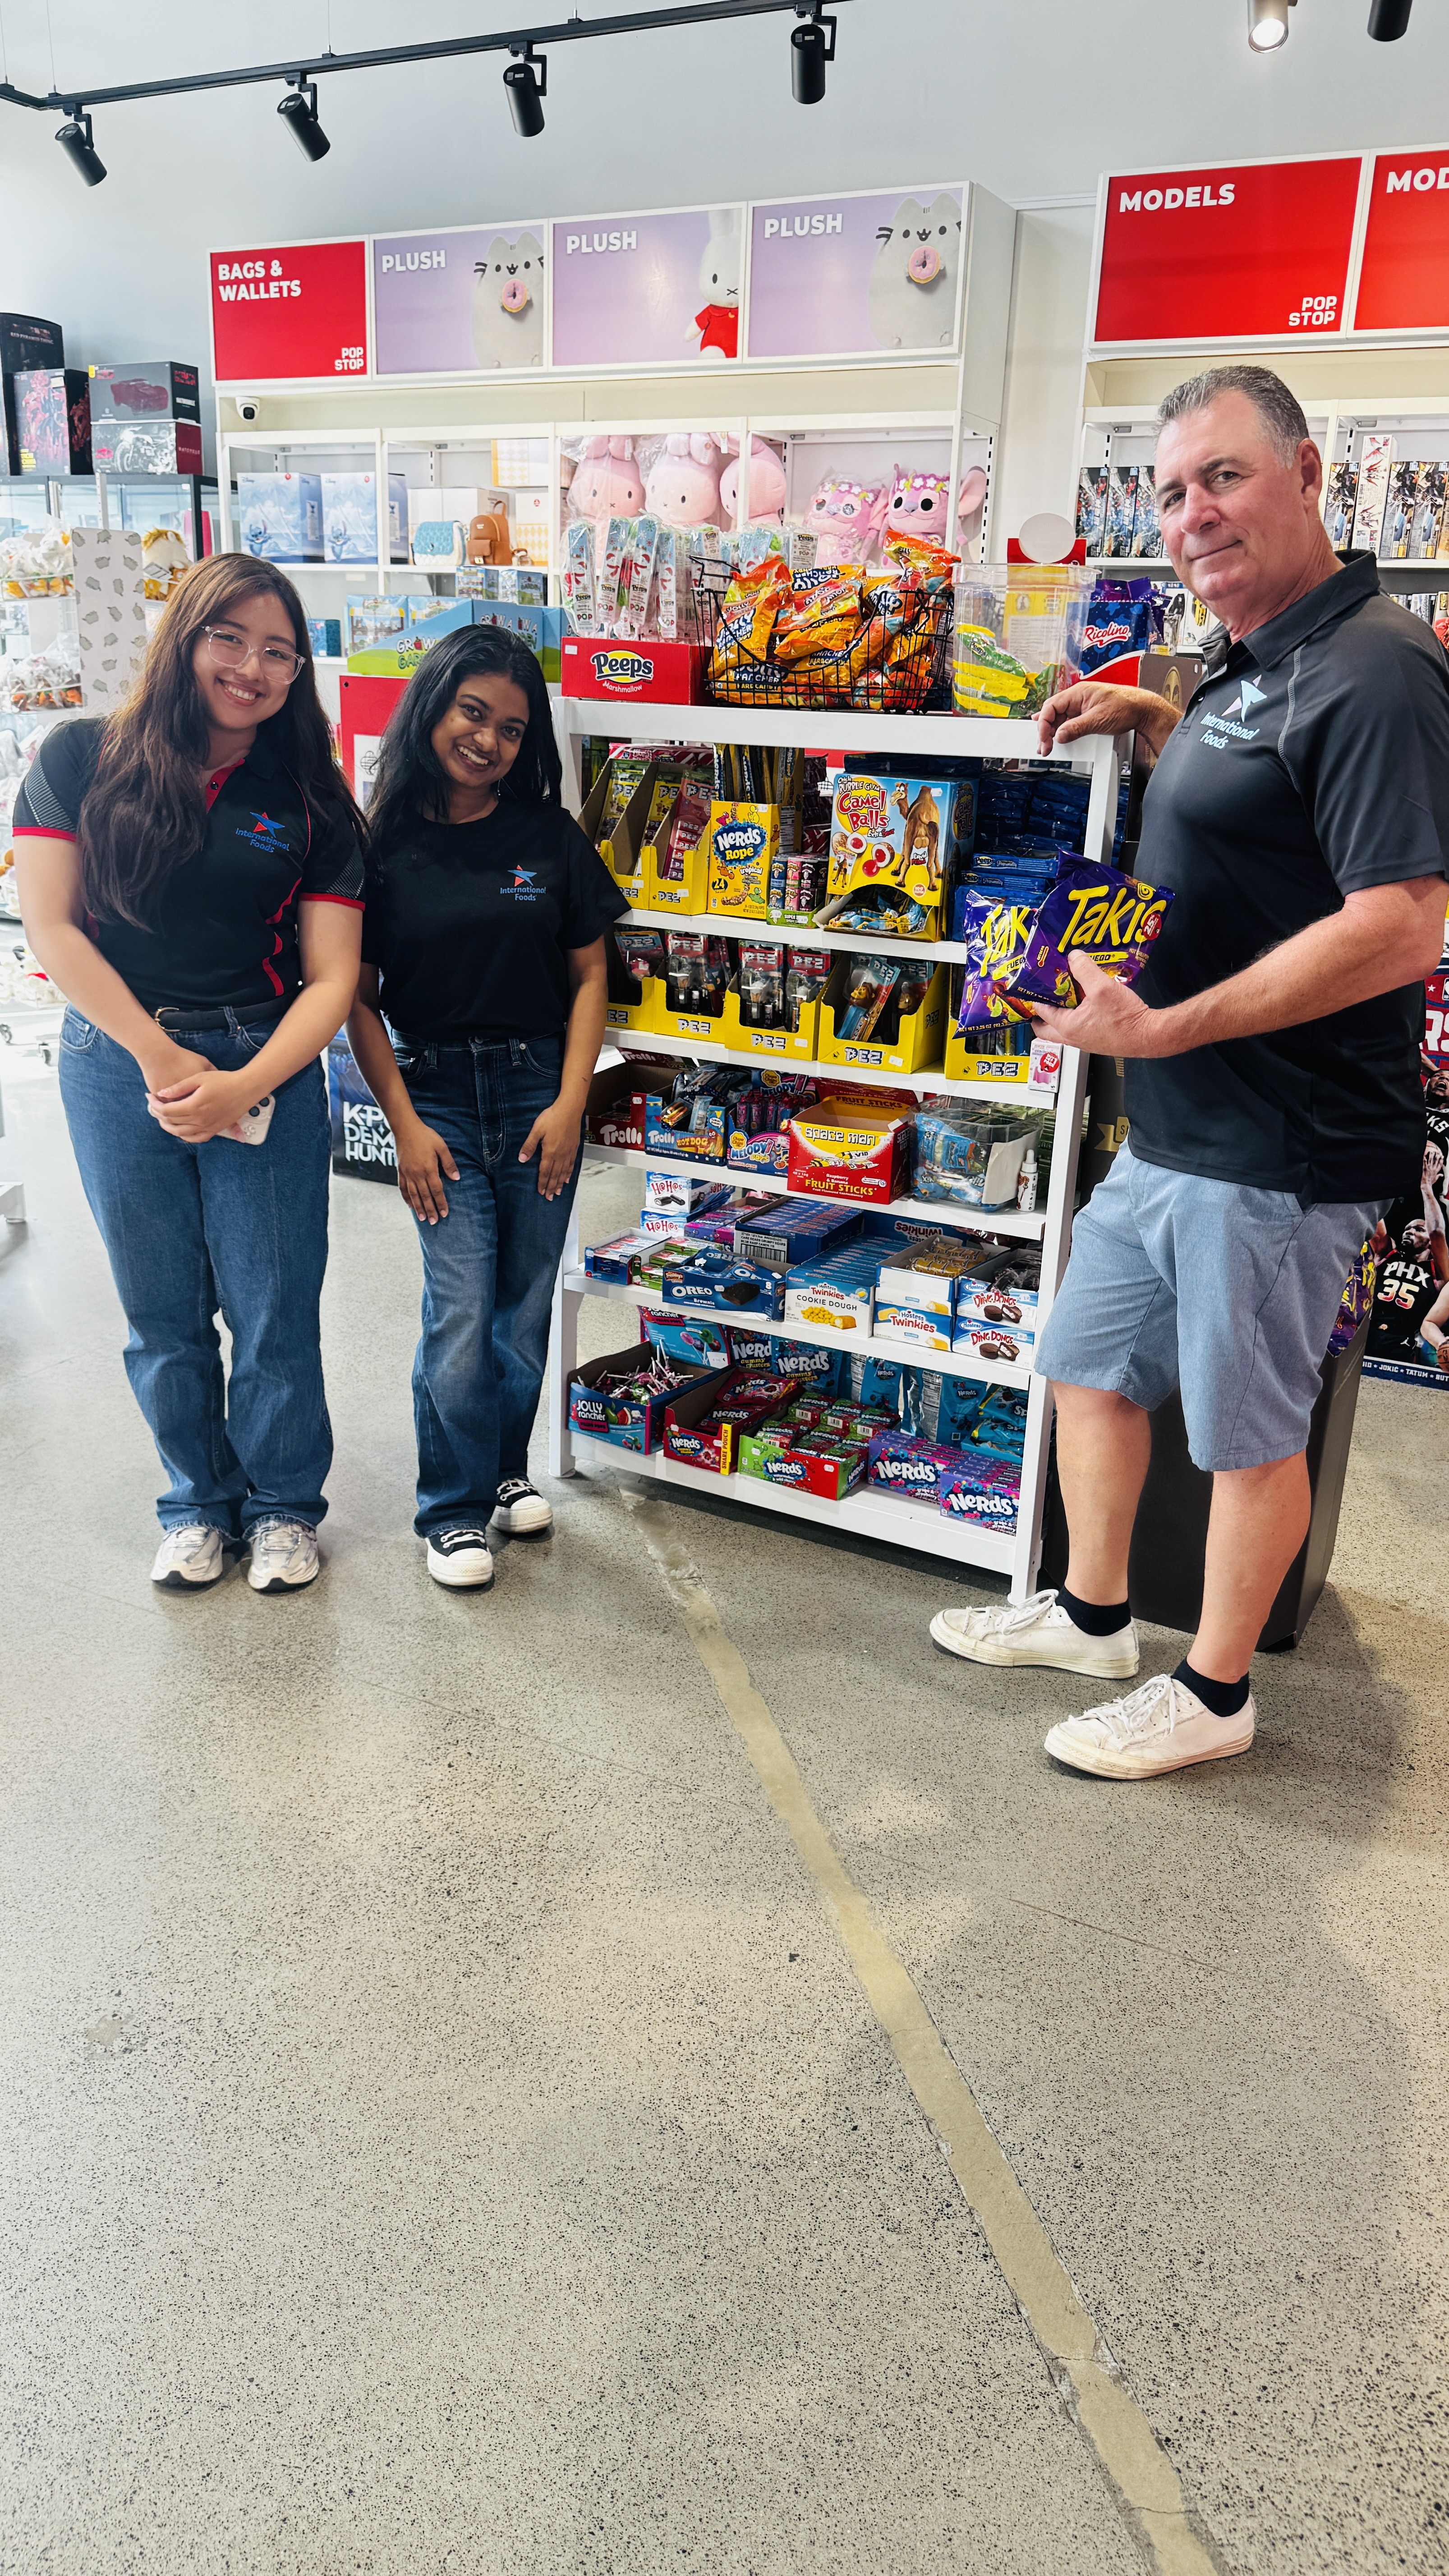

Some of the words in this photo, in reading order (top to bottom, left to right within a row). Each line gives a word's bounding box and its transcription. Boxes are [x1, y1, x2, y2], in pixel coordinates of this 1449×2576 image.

[1119, 184, 1235, 213] MODELS
[764, 214, 843, 238] PLUSH
[566, 230, 637, 254] PLUSH
[382, 250, 446, 273] PLUSH
[218, 261, 265, 281] BAGS
[270, 260, 283, 277] &
[219, 280, 301, 302] WALLETS
[1302, 296, 1337, 311] POP
[1288, 311, 1335, 326] STOP
[341, 347, 364, 359] POP
[335, 359, 364, 370] STOP
[1085, 622, 1129, 643] Ricolino
[590, 652, 653, 680] Peeps
[602, 681, 643, 694] Marshmallow
[1200, 712, 1260, 741] International
[1200, 729, 1229, 750] Foods
[838, 789, 887, 814] Camel
[848, 809, 890, 831] Balls
[235, 828, 290, 852] International
[681, 833, 697, 841] PEZ
[249, 838, 275, 853] Foods
[726, 847, 754, 860] Rope
[975, 856, 995, 865] Peeps
[500, 886, 547, 896] International
[713, 879, 725, 890] 24
[515, 893, 537, 902] Foods
[621, 937, 653, 947] PEZ
[745, 951, 777, 965] PEZ
[793, 955, 823, 969] PEZ
[874, 960, 894, 982] PEZ
[607, 1009, 628, 1024] EZ
[677, 1018, 711, 1034] PEZ
[750, 1034, 786, 1050] PEZ
[844, 1047, 883, 1065] PEZ
[976, 1061, 1019, 1077] PEZ
[761, 1082, 795, 1096] MELODY
[836, 1096, 865, 1104] FRUIT
[868, 1099, 903, 1108] STICKS
[600, 1124, 642, 1145] Trolli
[648, 1130, 675, 1144] Trolli
[690, 1137, 708, 1145] DOG
[731, 1142, 767, 1159] MELODY
[805, 1179, 835, 1191] FRUIT
[838, 1184, 874, 1195] STICKS
[895, 1221, 943, 1235] Twinkies
[1383, 1261, 1431, 1288] PHX
[672, 1286, 713, 1297] OREO
[765, 1281, 772, 1290] 8
[811, 1288, 845, 1300] Twinkies
[973, 1293, 992, 1308] DING
[993, 1290, 1016, 1306] DONGS
[1377, 1279, 1420, 1309] 35
[797, 1295, 826, 1305] COOKIE
[829, 1301, 857, 1311] DOUGH
[901, 1312, 924, 1321] Hostess
[890, 1316, 935, 1333] Twinkies
[971, 1331, 990, 1346] DING
[991, 1330, 1014, 1344] DONGS
[1379, 1364, 1399, 1373] JOKIC
[1405, 1368, 1429, 1378] TATUM
[576, 1399, 603, 1413] JOLLY
[578, 1411, 606, 1421] rancher
